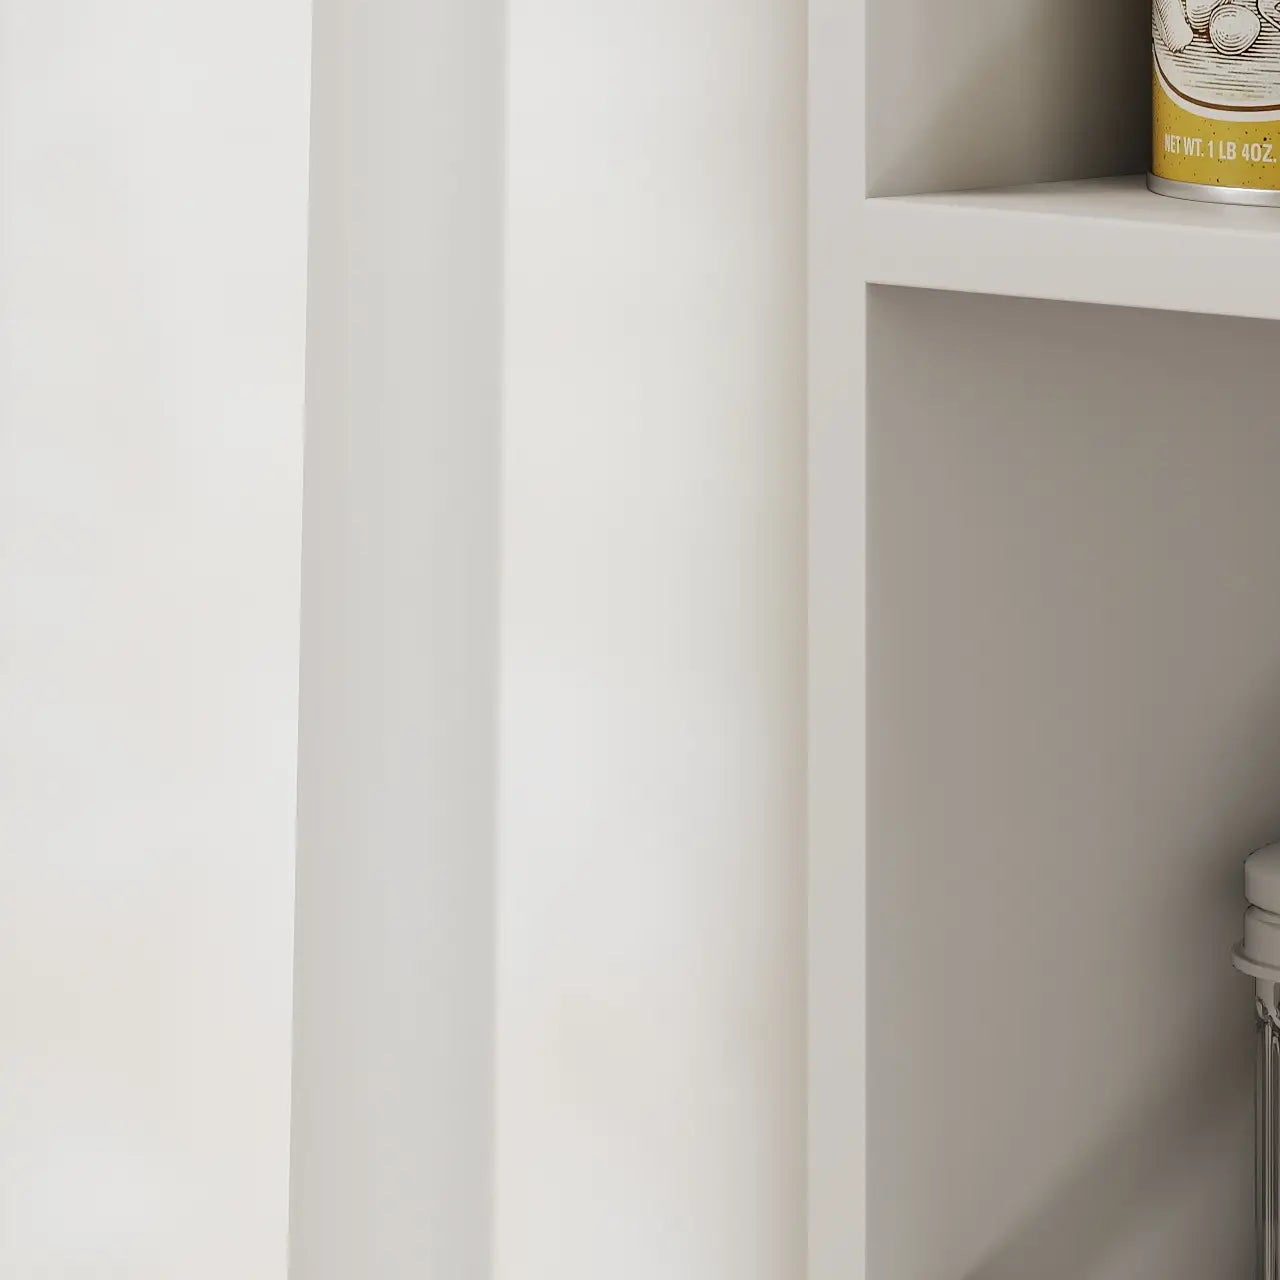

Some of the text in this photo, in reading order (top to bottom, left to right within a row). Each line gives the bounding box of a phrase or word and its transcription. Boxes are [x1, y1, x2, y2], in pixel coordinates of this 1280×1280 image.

[1164, 133, 1181, 153] NET
[1183, 137, 1204, 157] WT.
[1208, 141, 1214, 158] 1
[1219, 141, 1237, 160] LB
